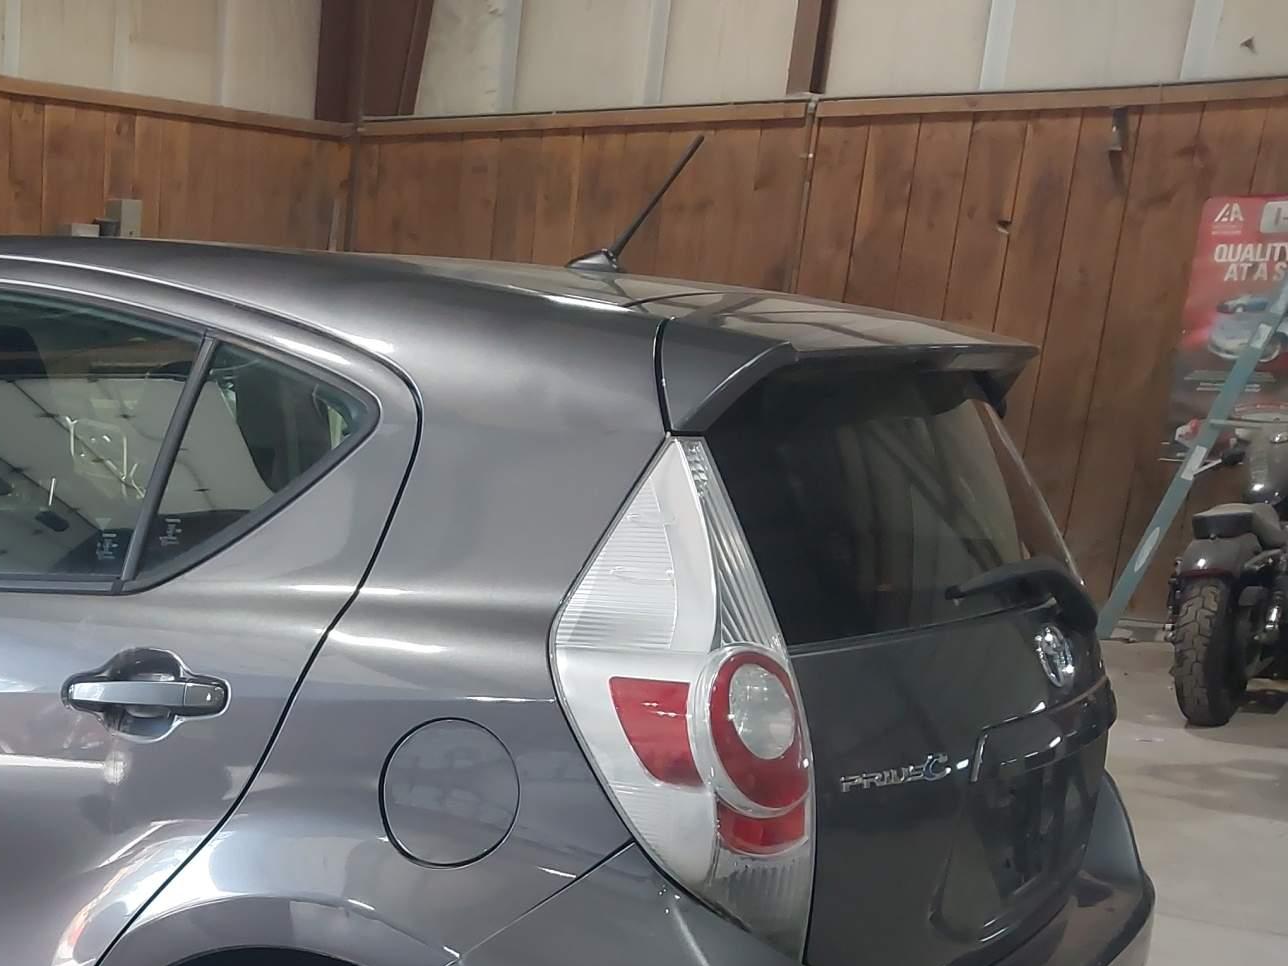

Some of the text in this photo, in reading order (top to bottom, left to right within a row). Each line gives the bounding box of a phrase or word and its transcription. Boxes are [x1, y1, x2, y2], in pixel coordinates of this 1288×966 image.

[1224, 263, 1252, 281] AT
[1253, 263, 1268, 281] A
[839, 766, 924, 793] PRIUS
